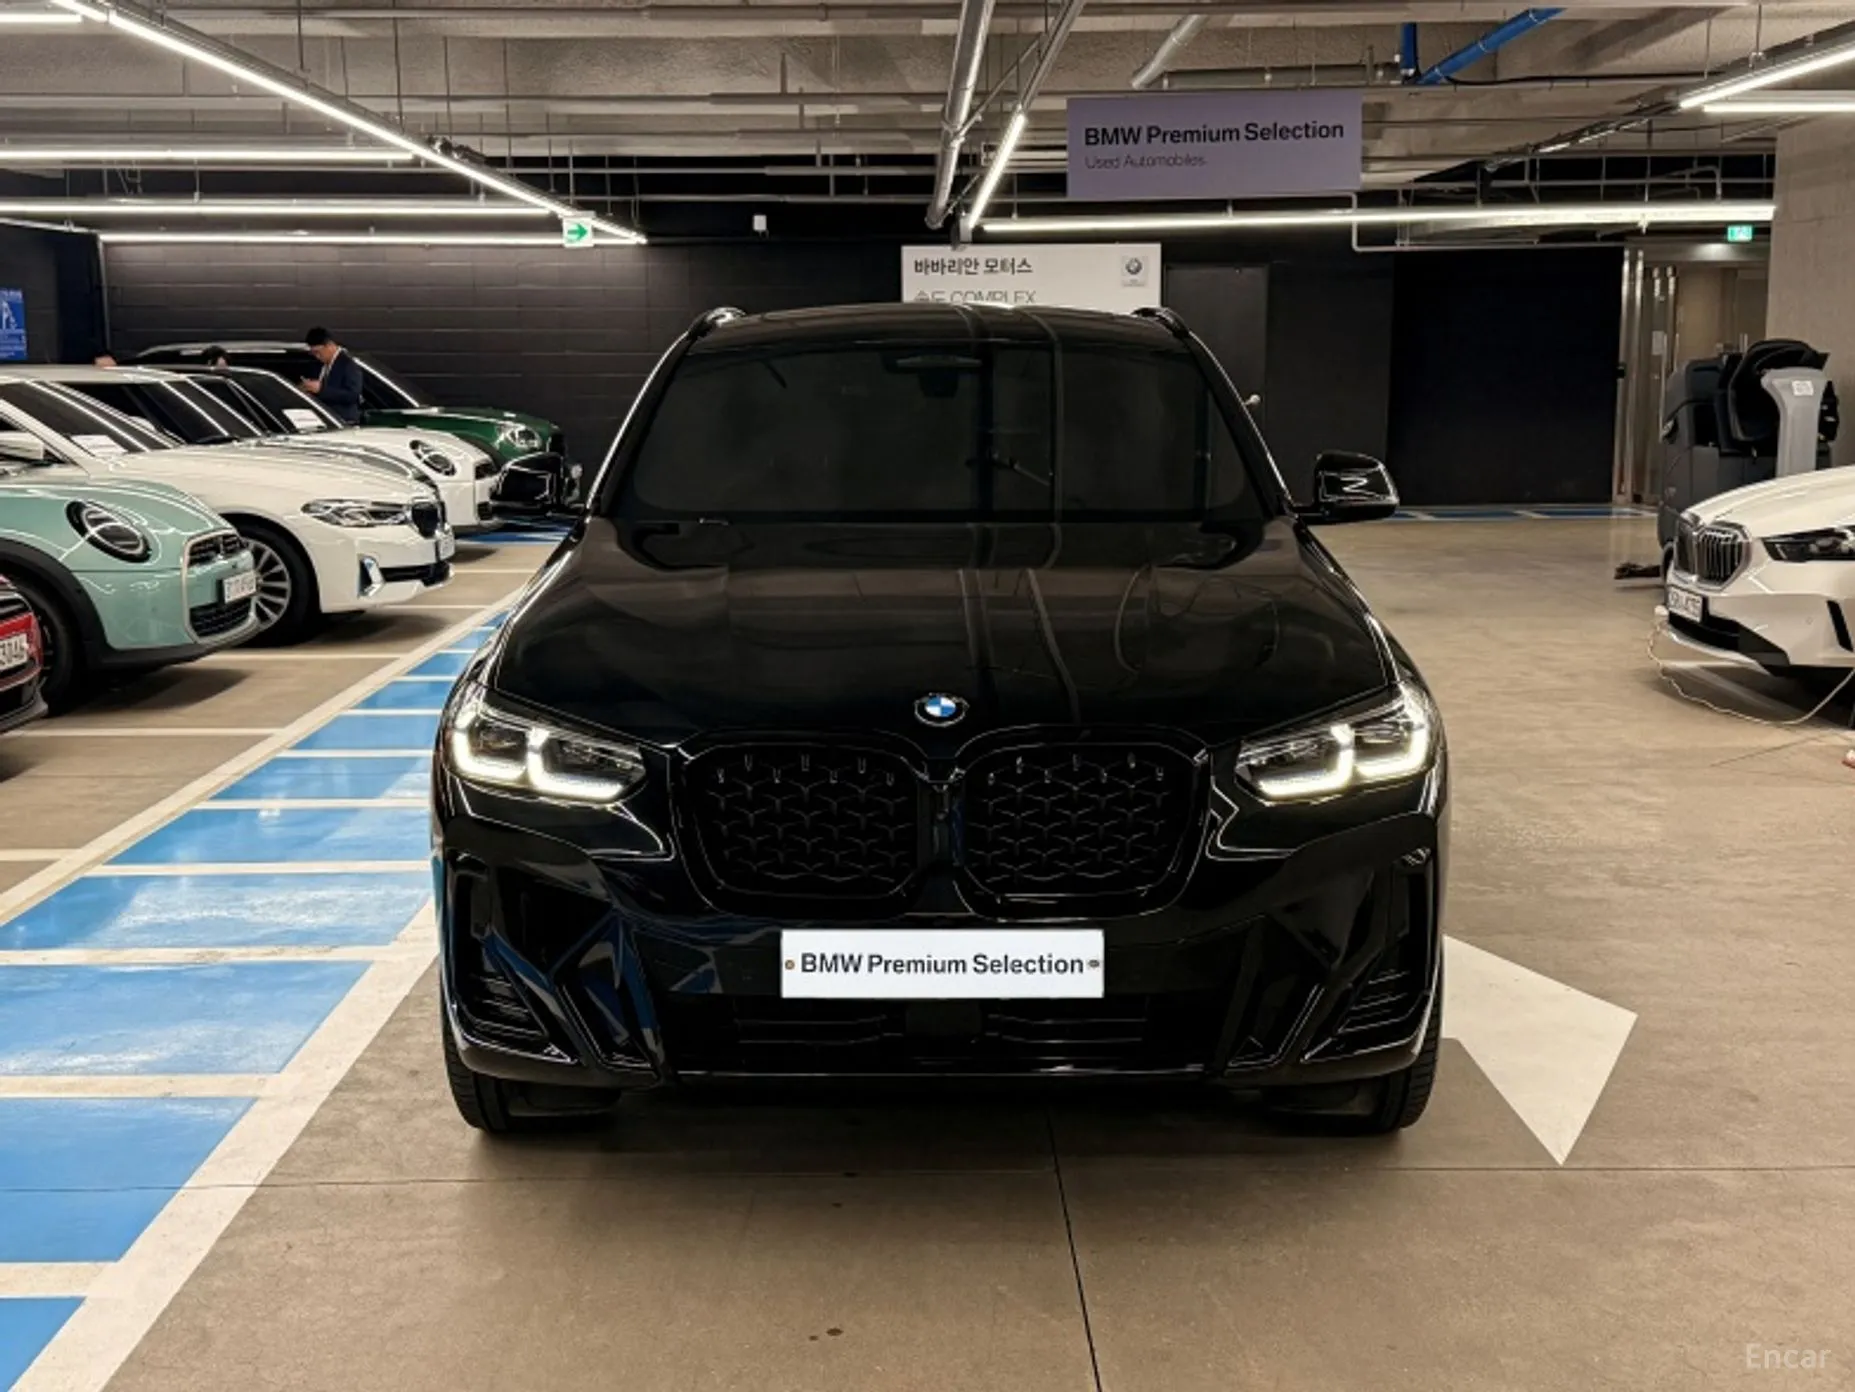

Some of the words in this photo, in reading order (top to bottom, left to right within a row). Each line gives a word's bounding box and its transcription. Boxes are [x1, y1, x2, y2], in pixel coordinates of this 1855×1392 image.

[1084, 126, 1142, 146] BMW
[1146, 124, 1241, 144] Premium
[1244, 120, 1345, 142] Selection
[1085, 155, 1120, 169] Used
[1123, 152, 1206, 168] Automobiles
[914, 257, 979, 276] 바바리안
[984, 257, 1034, 275] 모터스
[801, 953, 863, 973] BMW
[867, 953, 967, 974] Premium
[972, 953, 1084, 974] Selection
